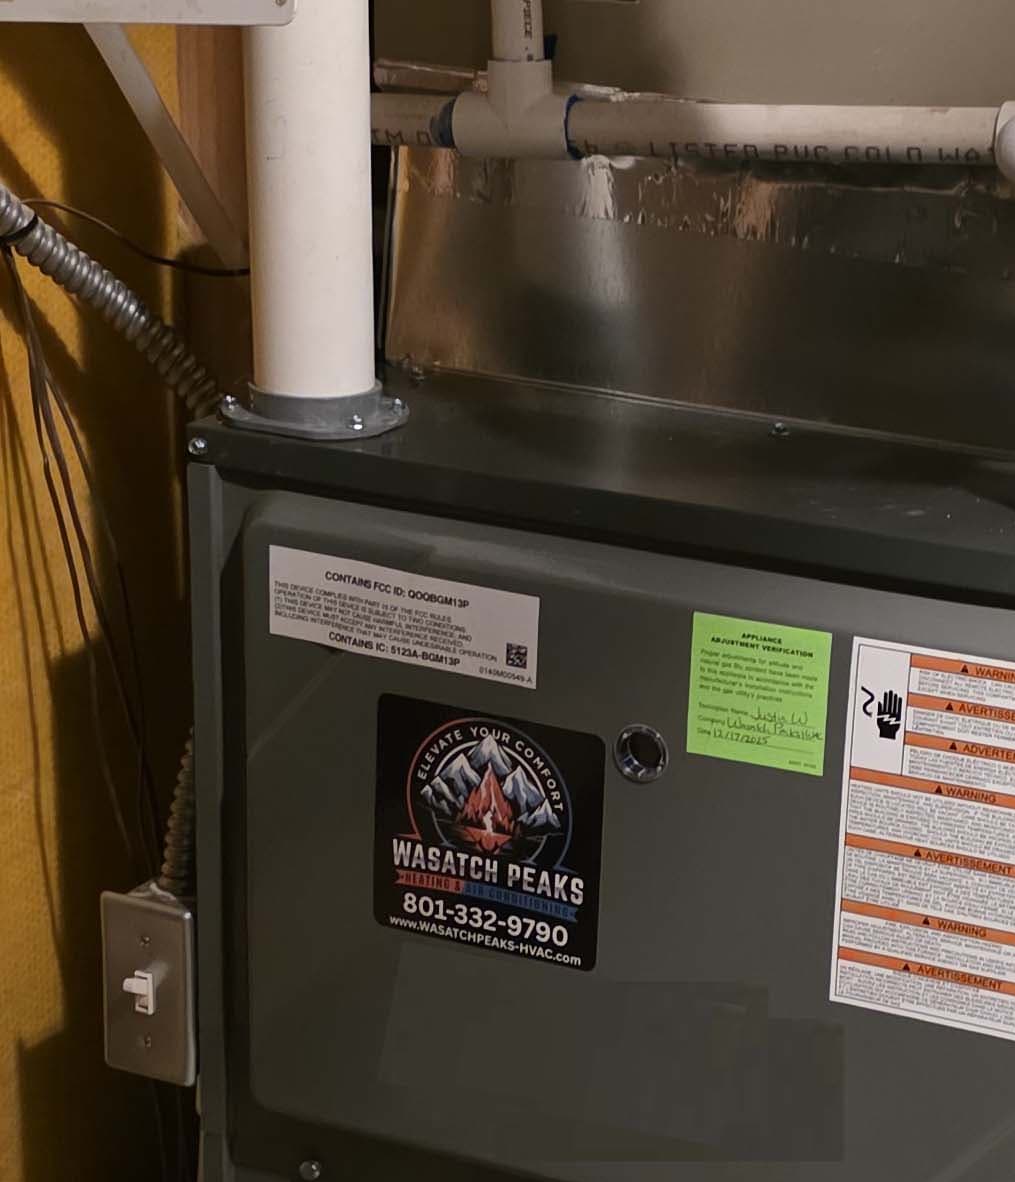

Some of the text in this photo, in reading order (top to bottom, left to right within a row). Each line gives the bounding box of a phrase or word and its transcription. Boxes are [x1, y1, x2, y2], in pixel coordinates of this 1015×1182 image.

[325, 570, 371, 589] CONTAINS
[373, 580, 391, 594] FCC
[393, 585, 405, 598] ID:
[328, 631, 460, 668] CONTAINS IC: 5123A-BGM13P
[710, 635, 813, 658] ADJUSTMENT VERIFICATION
[741, 631, 782, 644] APPLIANCE
[418, 725, 564, 812] ELEVATE YOUR COMFORT
[945, 785, 997, 803] WARNING
[392, 838, 585, 906] WASATCH PEAKS
[925, 850, 1012, 876] AVERTISSEMENT
[403, 892, 569, 947] 801-332-9790
[936, 919, 987, 938] WARNING
[916, 964, 1003, 990] AVERTISSEMENT
